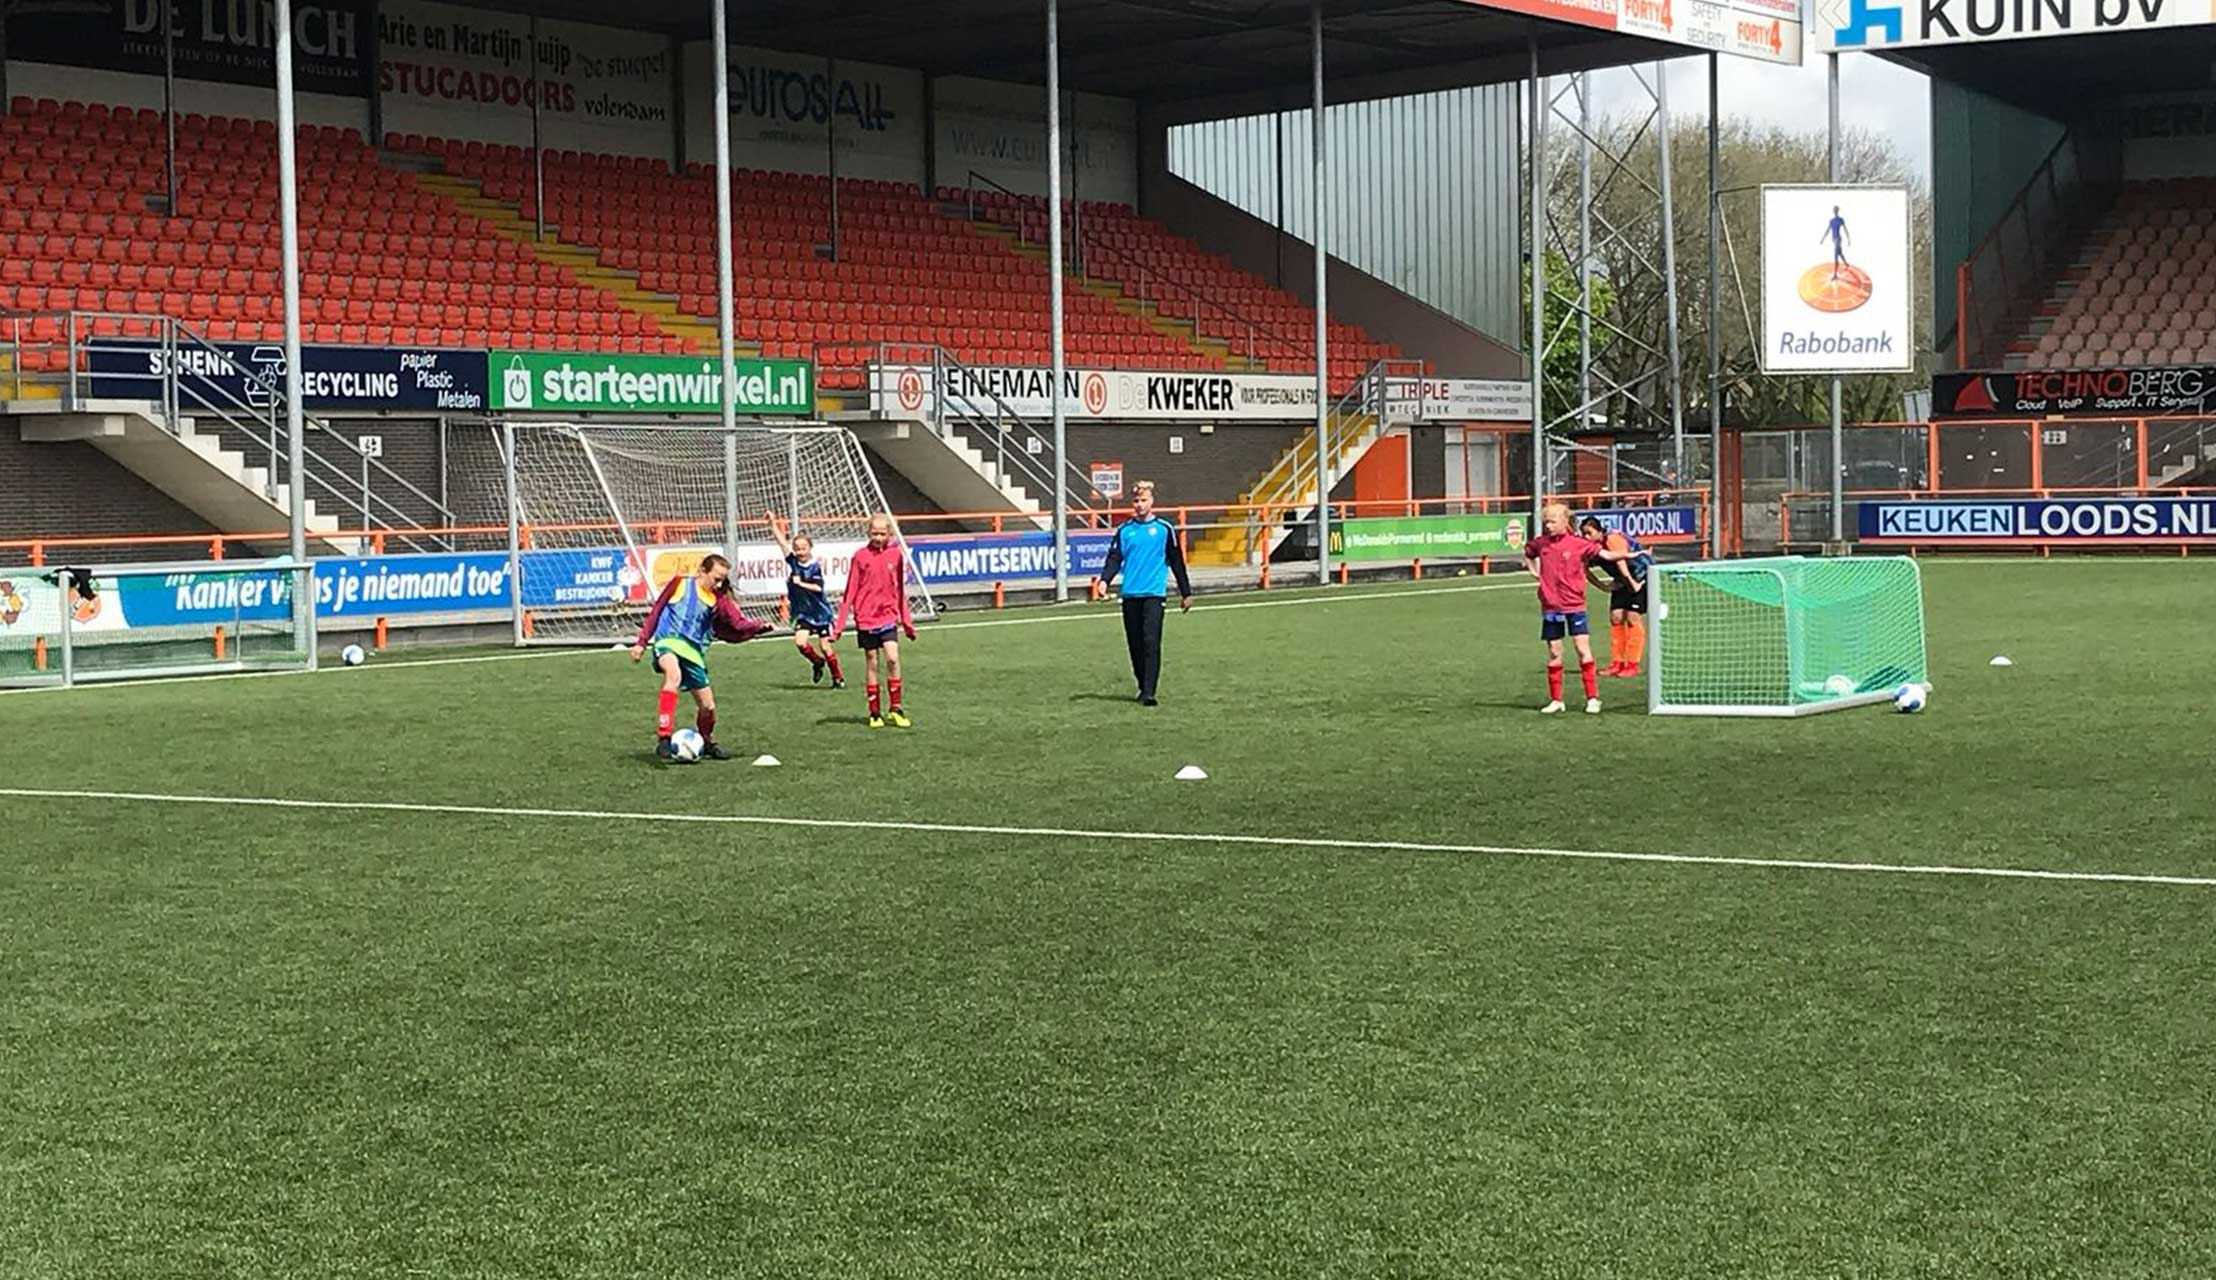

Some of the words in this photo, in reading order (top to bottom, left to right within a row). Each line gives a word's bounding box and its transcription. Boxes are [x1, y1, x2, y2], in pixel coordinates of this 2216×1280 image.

[1920, 0, 2070, 39] KUIN
[424, 25, 446, 49] en
[453, 24, 521, 66] Martijn
[379, 60, 575, 112] STUCADOORS
[584, 92, 664, 120] volendam
[1780, 330, 1893, 354] Rabobank
[416, 370, 453, 388] Plastic
[1401, 383, 1449, 400] TRPLE
[2016, 369, 2203, 399] TECHNOBERG
[437, 390, 480, 408] Metalen
[1148, 377, 1233, 410] KWEKER
[2016, 399, 2047, 411] Cloud
[2146, 396, 2158, 407] IT
[591, 556, 613, 568] KWF
[333, 567, 359, 612] je
[363, 563, 465, 602] niemand
[575, 571, 613, 584] KANKER
